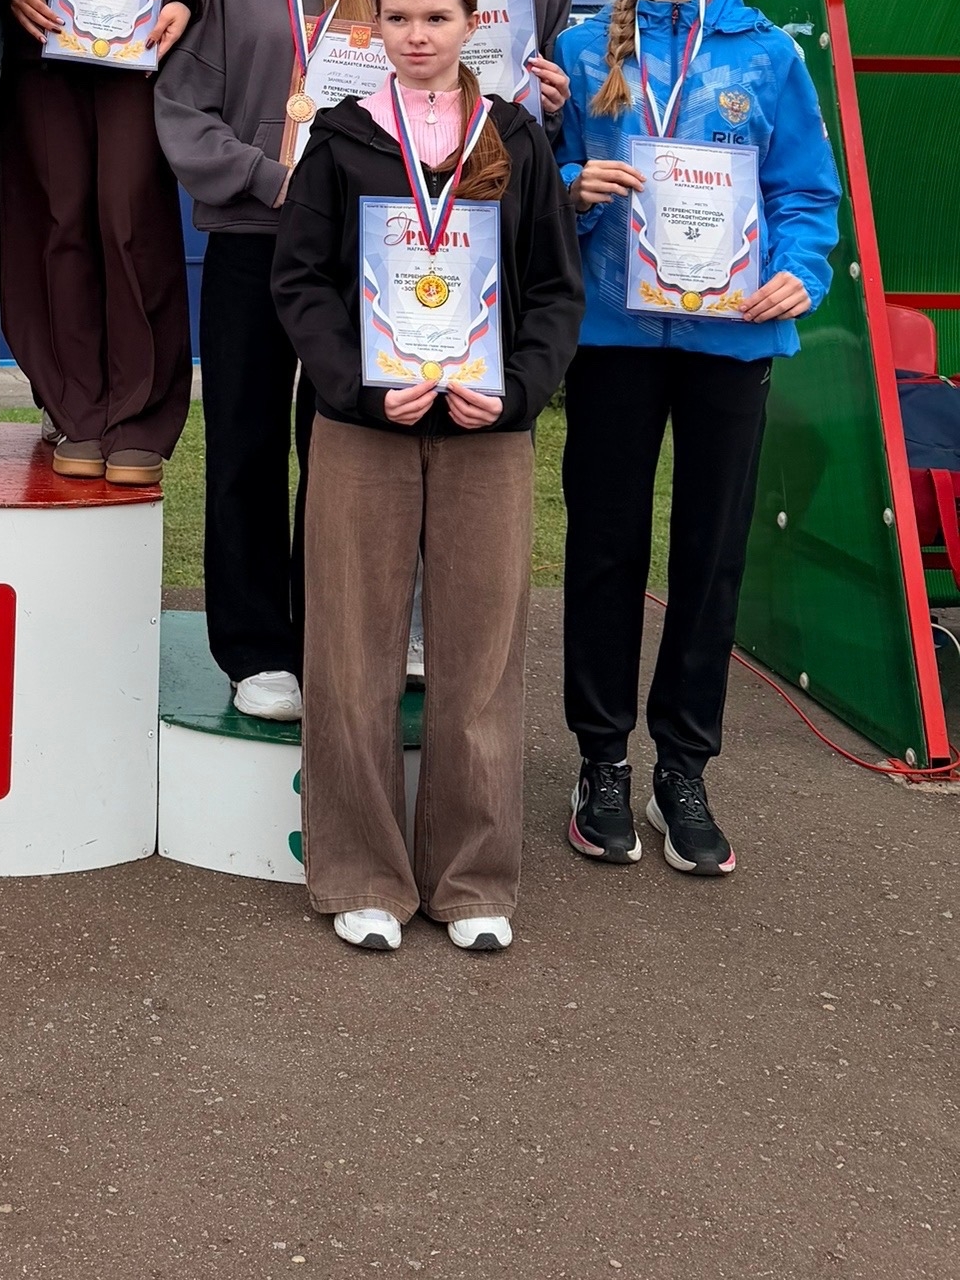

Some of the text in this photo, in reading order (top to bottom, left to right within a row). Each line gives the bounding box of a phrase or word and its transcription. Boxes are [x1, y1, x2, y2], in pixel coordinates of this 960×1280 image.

[328, 48, 386, 64] ДИПЛОМ
[323, 58, 389, 71] НАГРАЖДАЕТСЯ КОМАНДА
[328, 86, 358, 94] ПЕРВЕНСТВЕ
[652, 150, 732, 187] ГРАМОТА
[667, 207, 701, 215] ПЕРВЕНСТВЕ
[671, 213, 711, 222] ЭСТАФЕТНОМУ
[383, 211, 470, 248] ГРАОТА
